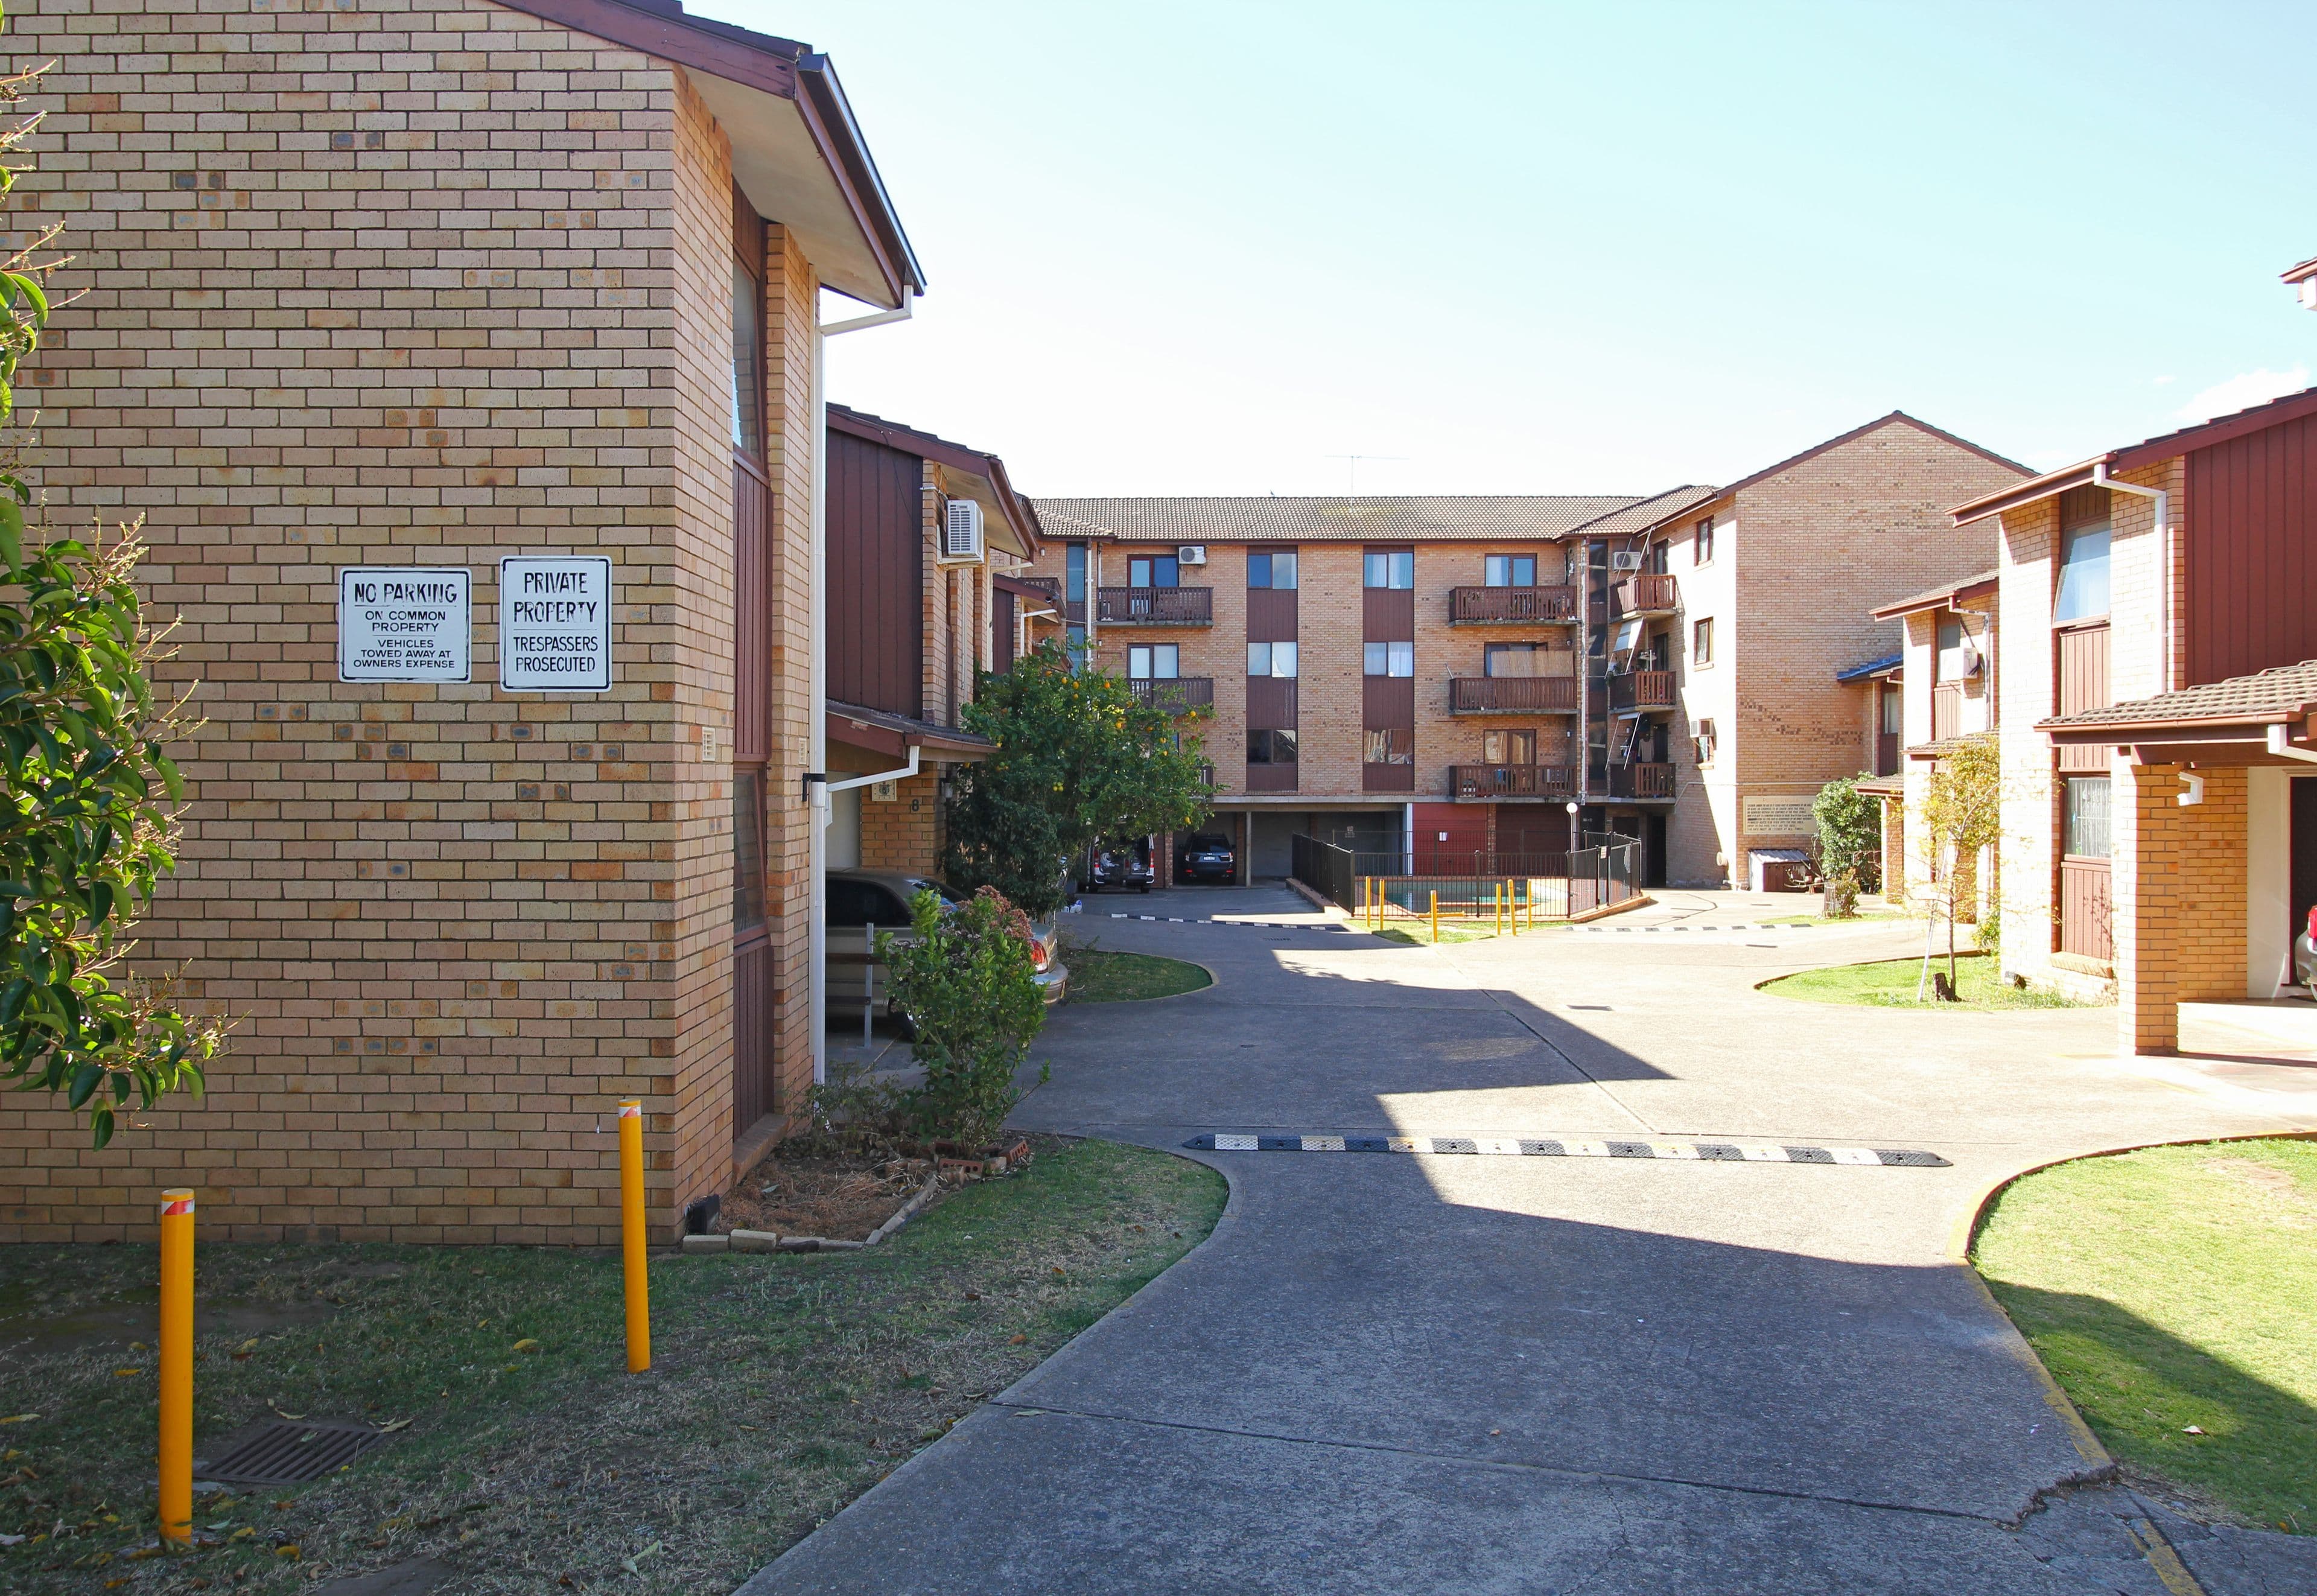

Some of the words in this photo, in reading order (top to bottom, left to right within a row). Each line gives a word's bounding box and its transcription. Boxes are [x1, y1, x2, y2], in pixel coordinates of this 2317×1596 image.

[524, 572, 588, 594] PRIVATE
[354, 583, 377, 603] NO
[384, 583, 457, 603] PARKING
[365, 611, 383, 620] ON
[389, 611, 446, 620] COMMON
[514, 601, 597, 623] PROPERTY
[372, 622, 439, 632] PROPERTY
[378, 640, 434, 648] VEHICLES
[513, 636, 598, 652] TRESPASSERS
[361, 649, 402, 658] TOWED
[405, 650, 436, 658] AWAY
[438, 650, 451, 658] AT
[516, 657, 596, 672] PROSECUTED
